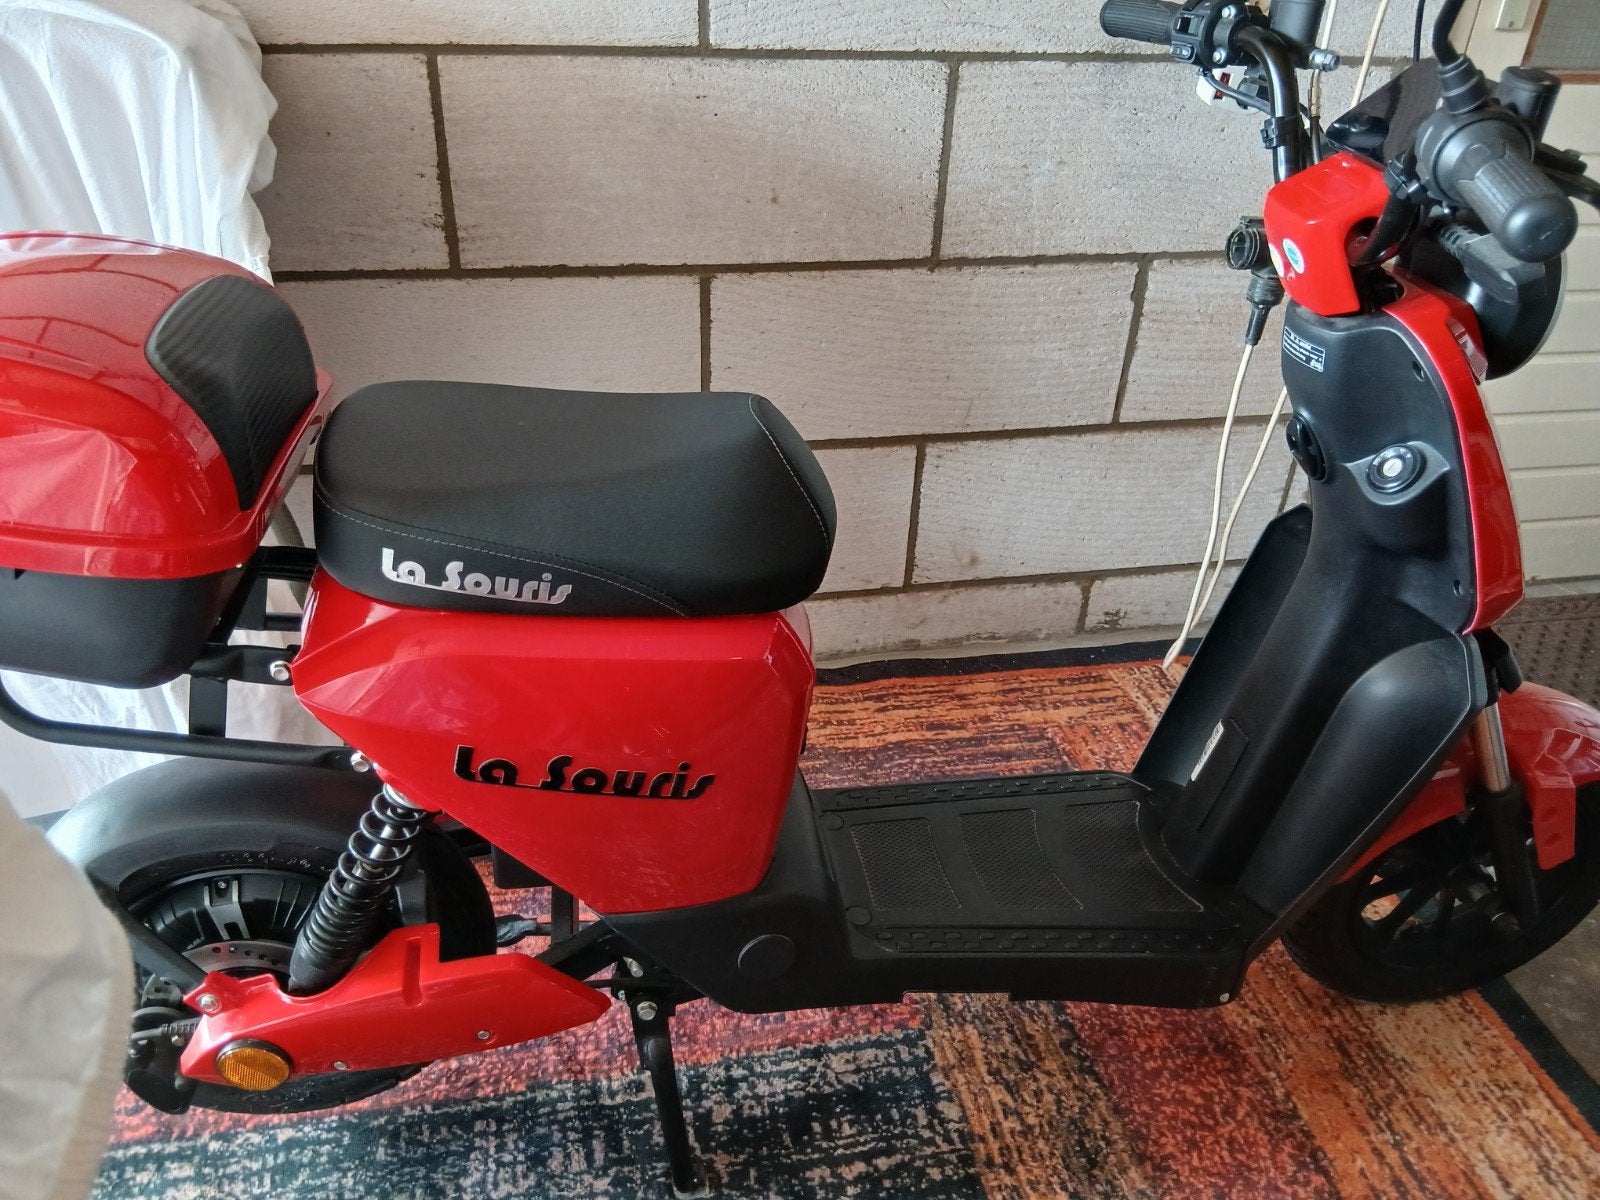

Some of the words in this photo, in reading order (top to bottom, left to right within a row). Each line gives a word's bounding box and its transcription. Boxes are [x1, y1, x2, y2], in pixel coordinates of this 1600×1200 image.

[382, 547, 426, 586] La
[441, 561, 572, 605] Souris
[453, 744, 518, 787] La
[539, 755, 716, 801] Souris
